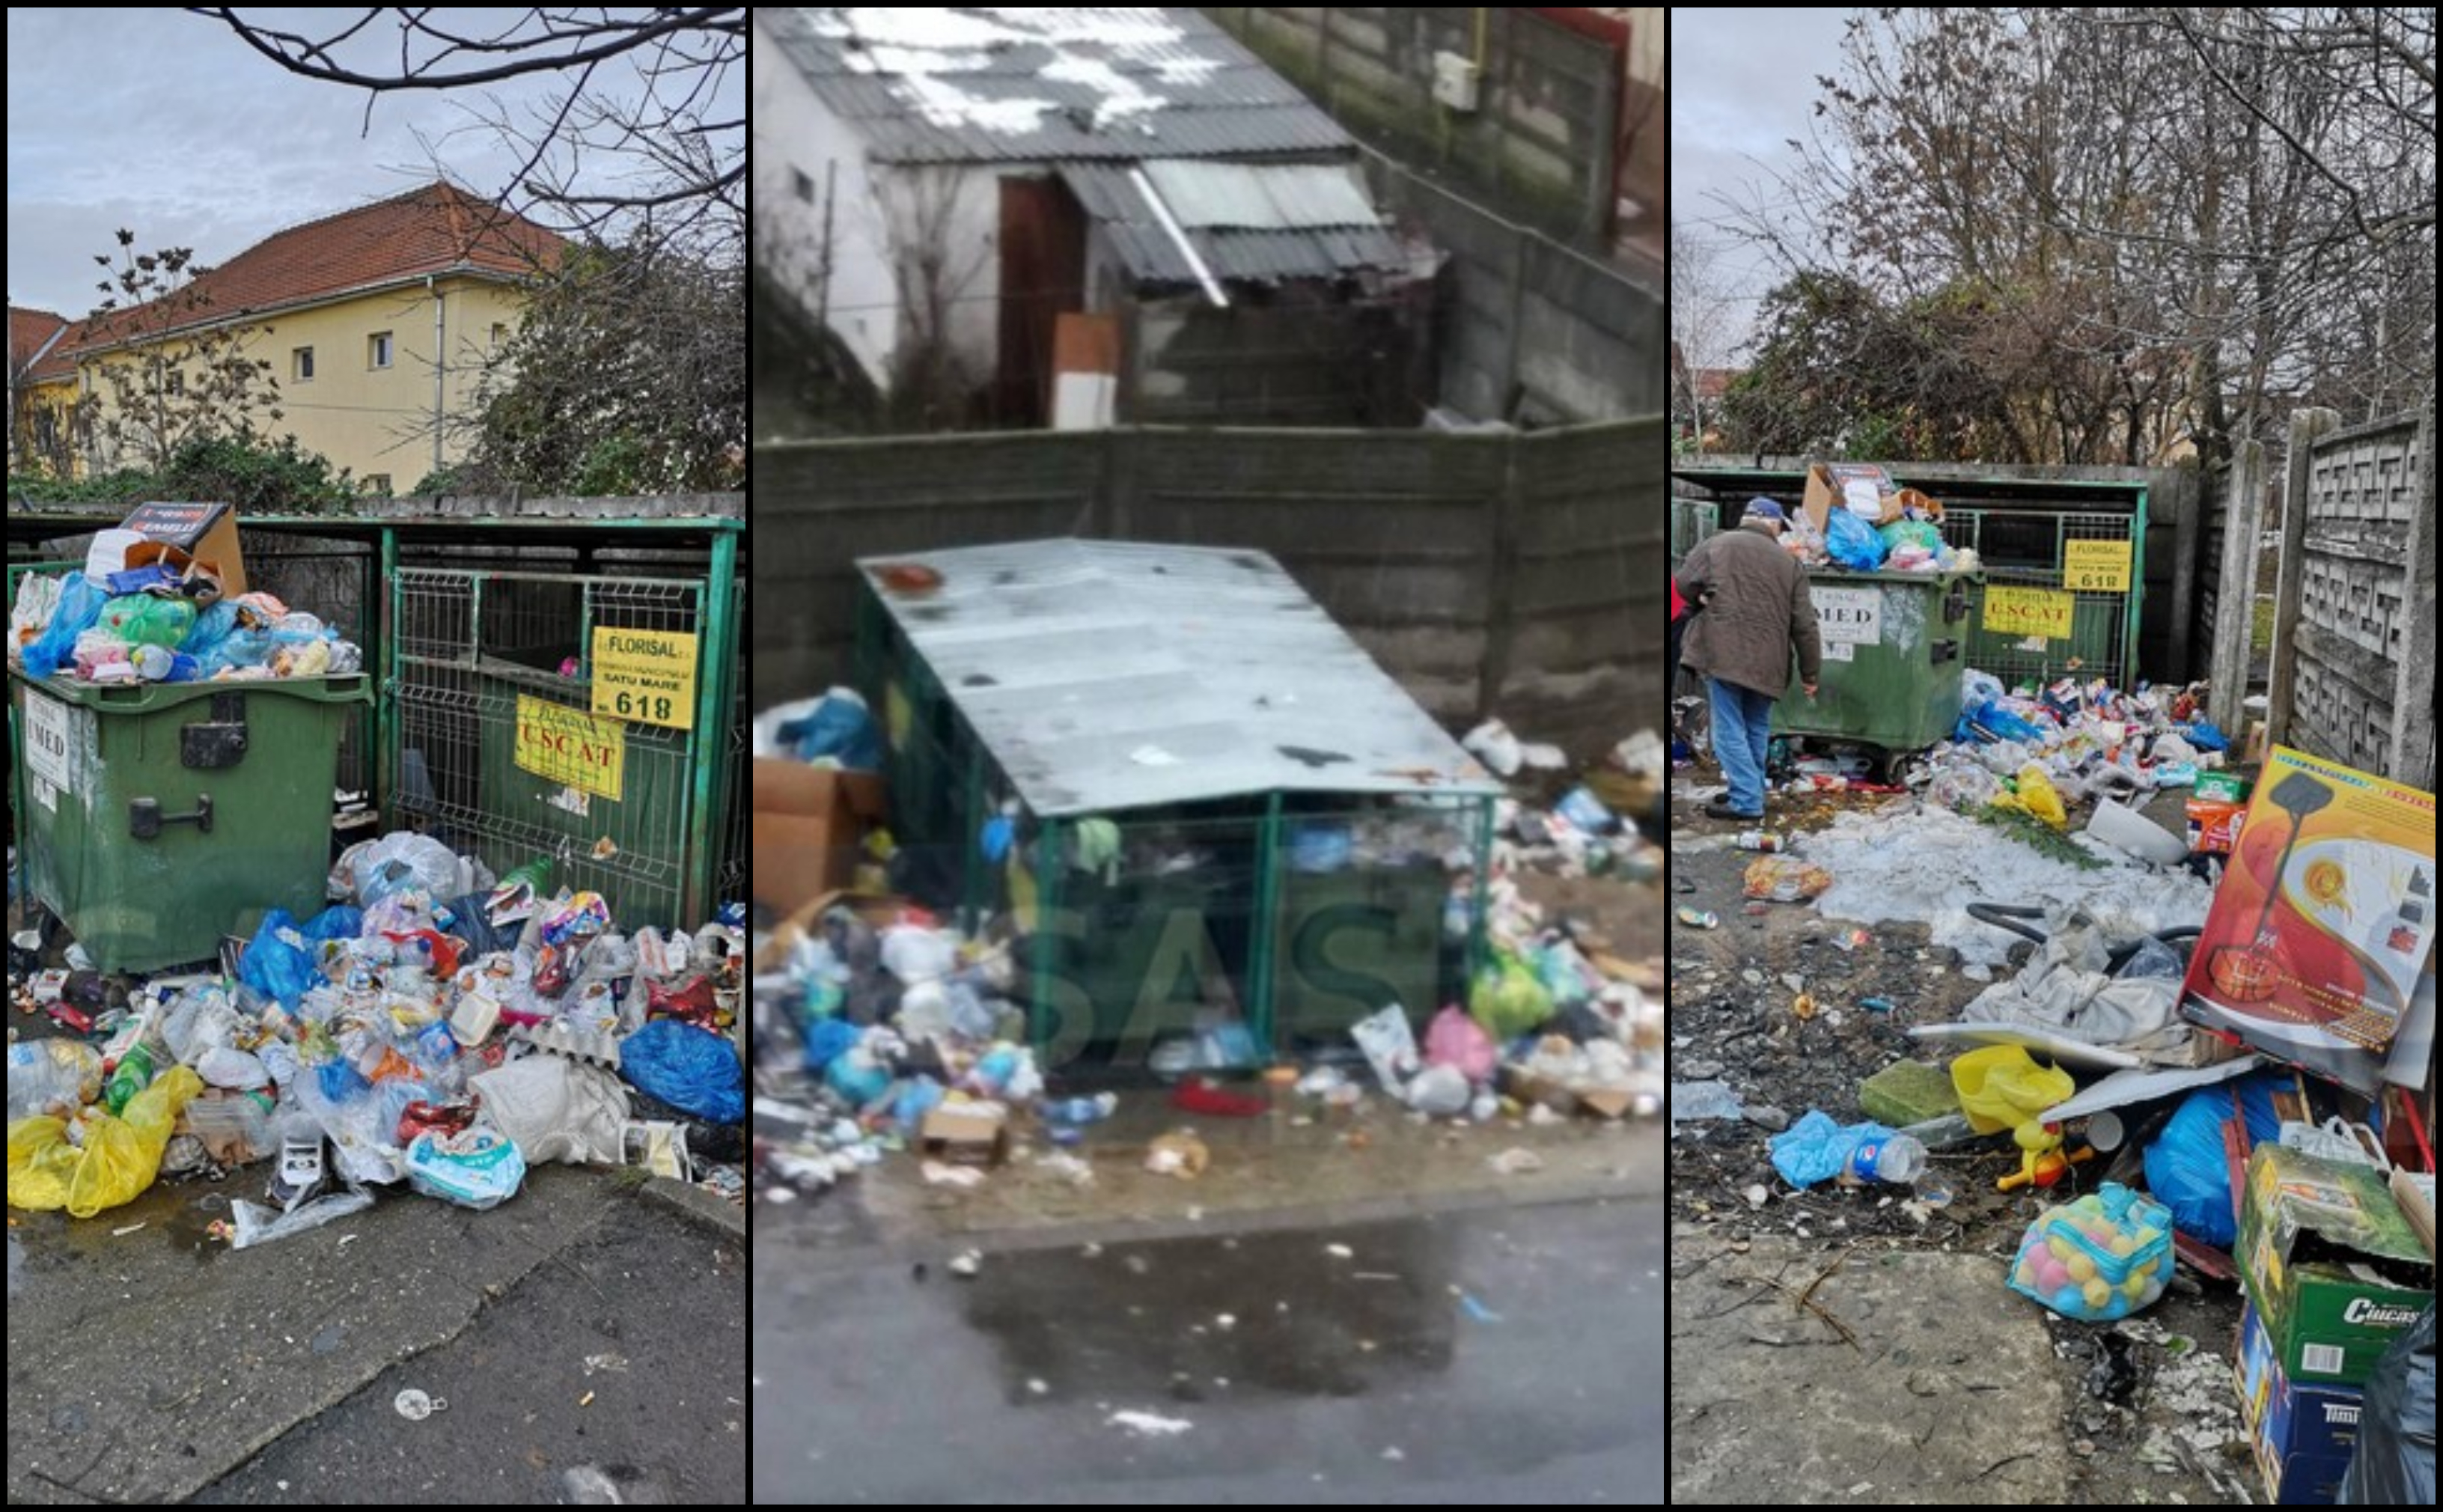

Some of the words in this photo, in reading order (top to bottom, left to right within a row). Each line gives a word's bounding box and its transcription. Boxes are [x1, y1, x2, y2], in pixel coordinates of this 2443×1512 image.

[609, 636, 677, 659] FLORISAL
[604, 674, 637, 684] SATU
[641, 678, 679, 691] MARE
[616, 691, 671, 720] 618
[522, 724, 614, 766] USCAT
